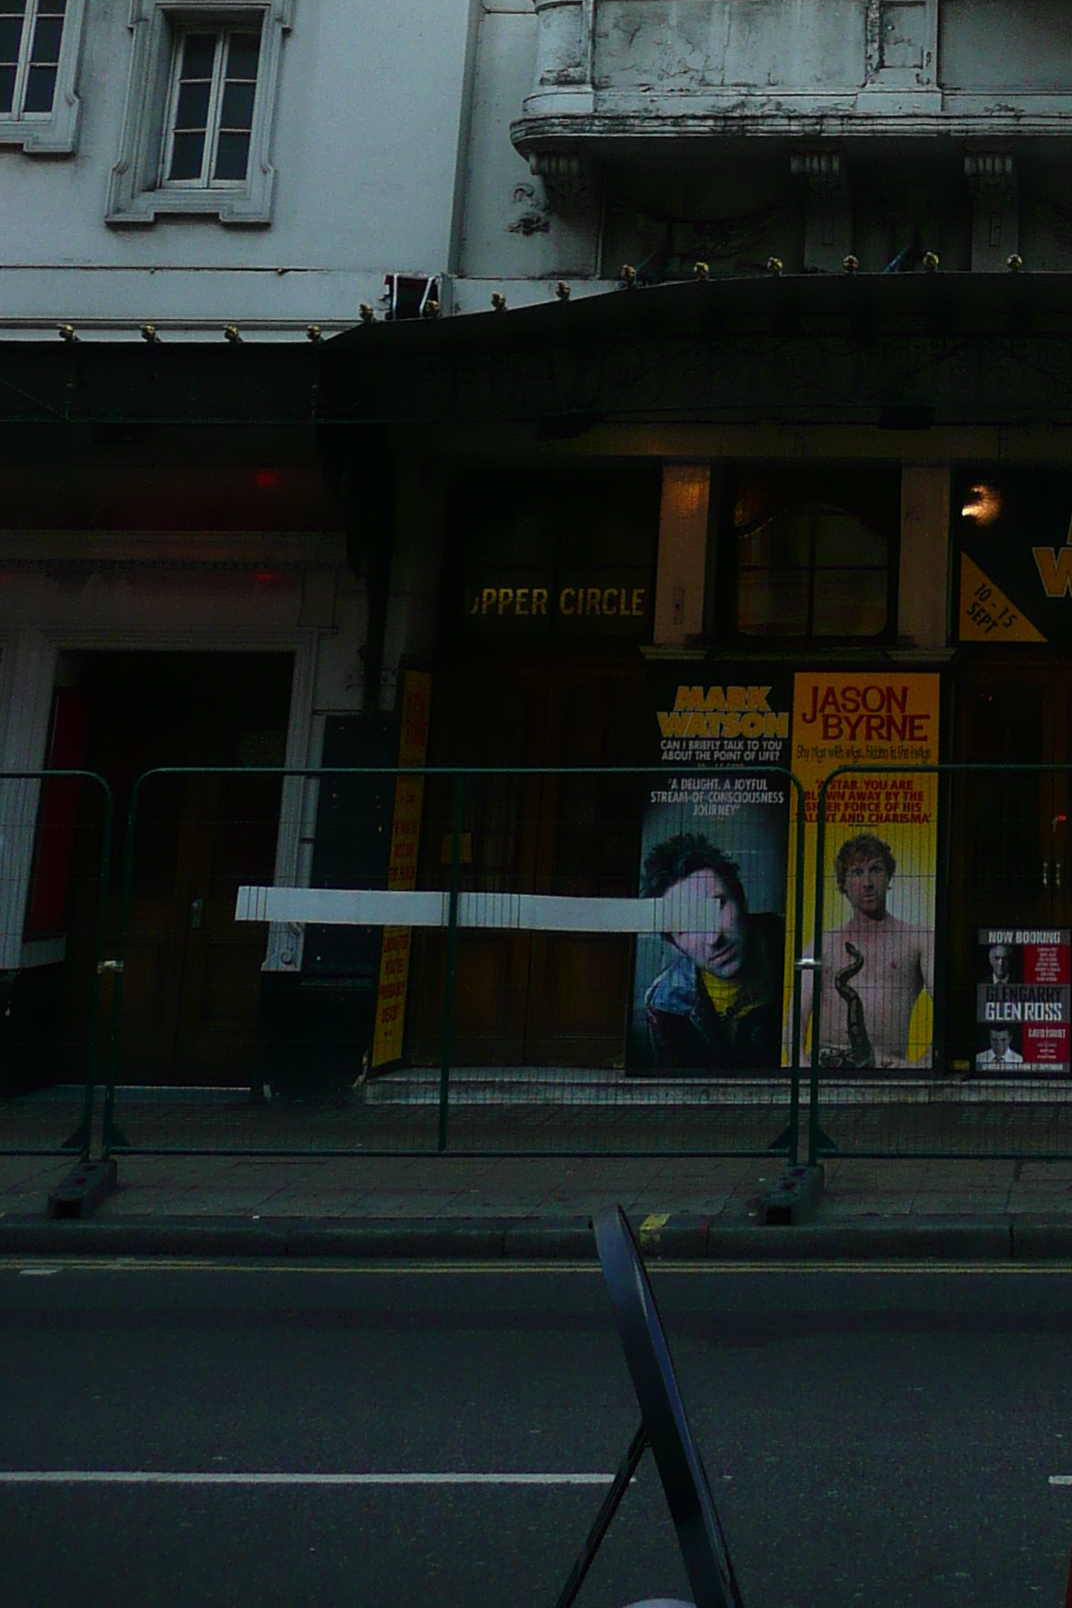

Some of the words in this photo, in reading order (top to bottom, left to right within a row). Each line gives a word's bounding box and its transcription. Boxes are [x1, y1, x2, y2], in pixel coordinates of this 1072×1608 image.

[559, 586, 646, 616] CIRCLE
[972, 582, 992, 602] 10
[998, 607, 1019, 629] 15
[965, 603, 998, 634] SEPT
[673, 685, 772, 712] MARK
[802, 685, 908, 723] JASON
[656, 711, 789, 739] WATSON
[821, 713, 931, 742] BYRNE
[660, 739, 680, 750] CAN
[688, 739, 720, 750] BRIEFLY
[723, 739, 744, 750] TALK
[746, 740, 758, 750] TO
[761, 740, 782, 750] YOU
[661, 751, 692, 761] ABOUT
[695, 751, 711, 761] THE
[714, 751, 740, 761] POINT
[743, 751, 756, 761] OF
[759, 751, 780, 762] LIFE?
[723, 779, 731, 790] A
[734, 779, 768, 790] JOYFUL
[864, 780, 888, 790] YOU
[891, 780, 914, 790] ARE
[804, 791, 846, 801] BLWN
[848, 791, 881, 801] AWAY
[885, 791, 900, 801] BY
[903, 791, 924, 801] THE
[804, 802, 841, 812] SHER
[844, 802, 881, 812] FORCE
[884, 802, 900, 812] OF
[903, 802, 922, 812] HIS
[840, 813, 866, 823] AND
[988, 931, 1013, 944] NOW
[1015, 931, 1061, 944] BOOKING
[986, 984, 1063, 1002] GLENGARRY
[985, 1001, 1021, 1021] GLEN
[1024, 1001, 1063, 1021] ROSS
